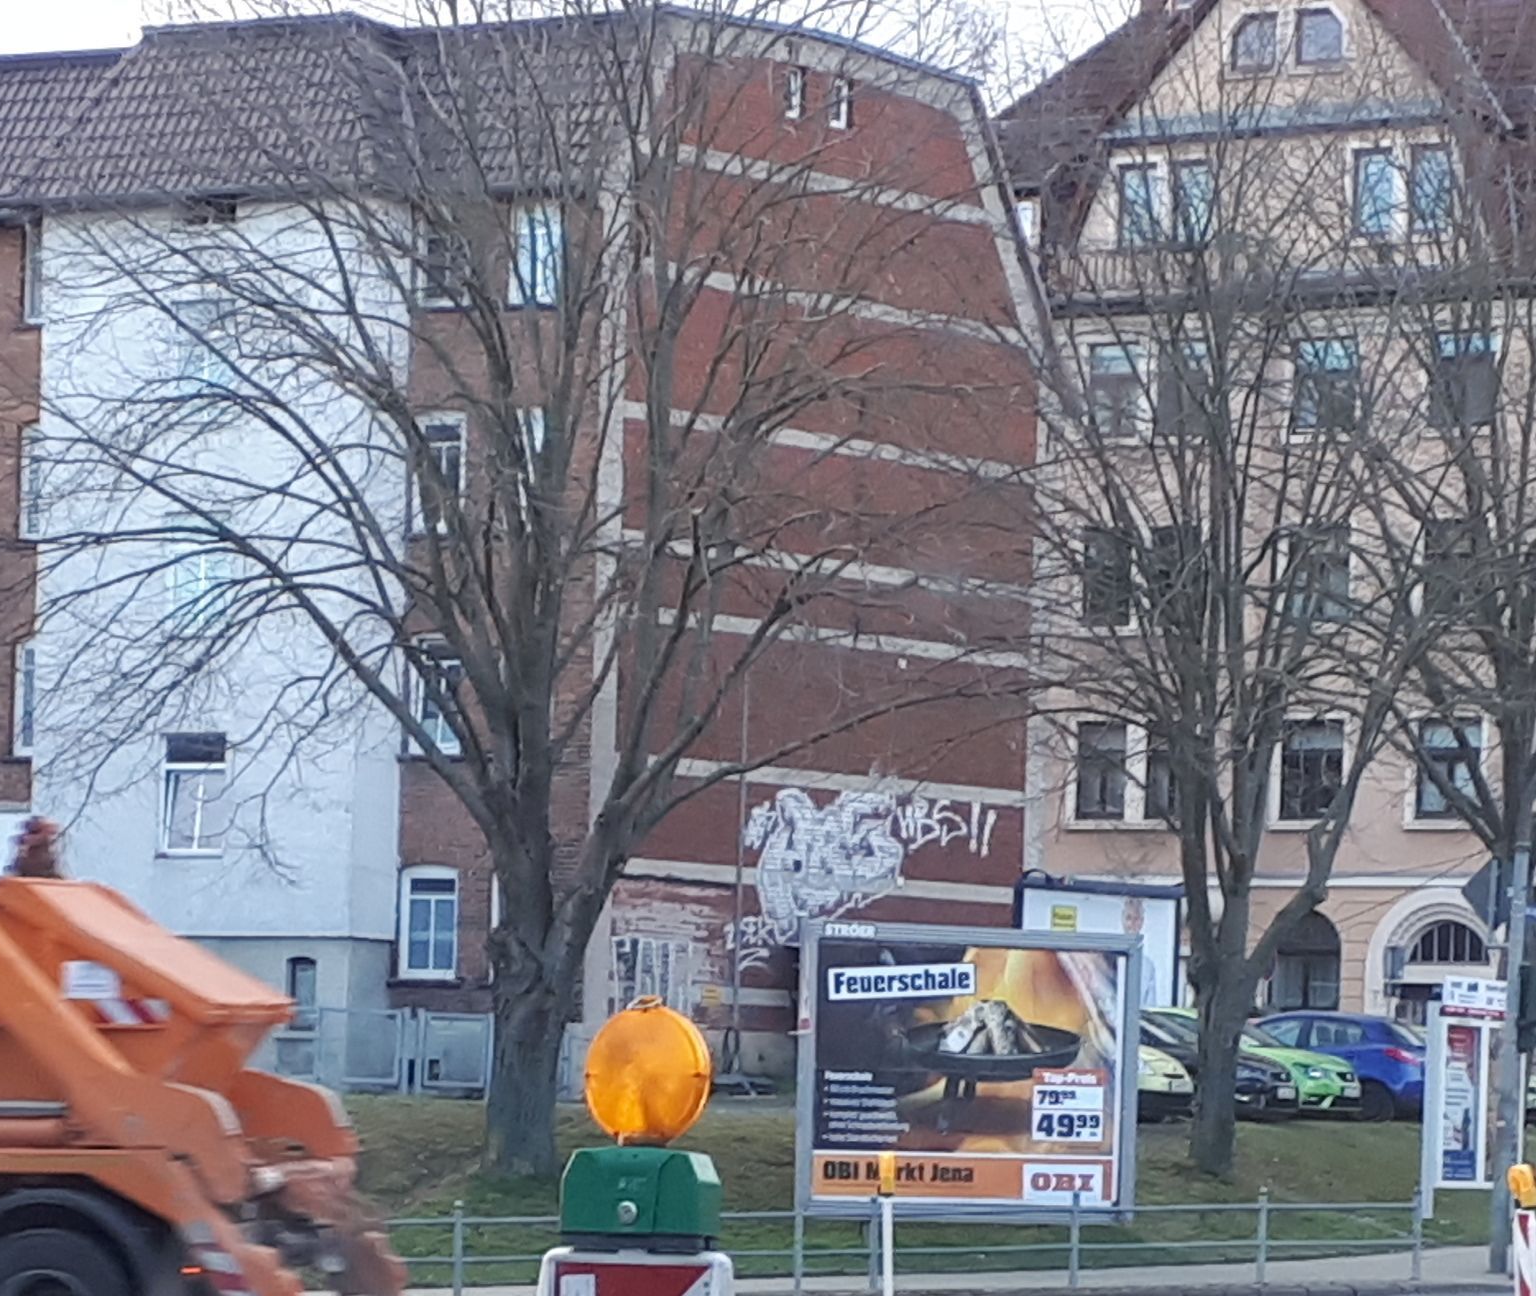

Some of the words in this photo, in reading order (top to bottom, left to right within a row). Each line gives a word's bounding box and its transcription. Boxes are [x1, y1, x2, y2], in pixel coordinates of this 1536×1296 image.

[833, 968, 971, 994] Feuerschale
[823, 1160, 859, 1180] OBI
[866, 1162, 925, 1182] Mrkt
[930, 1164, 974, 1183] Jena
[1030, 1172, 1094, 1192] OBI
